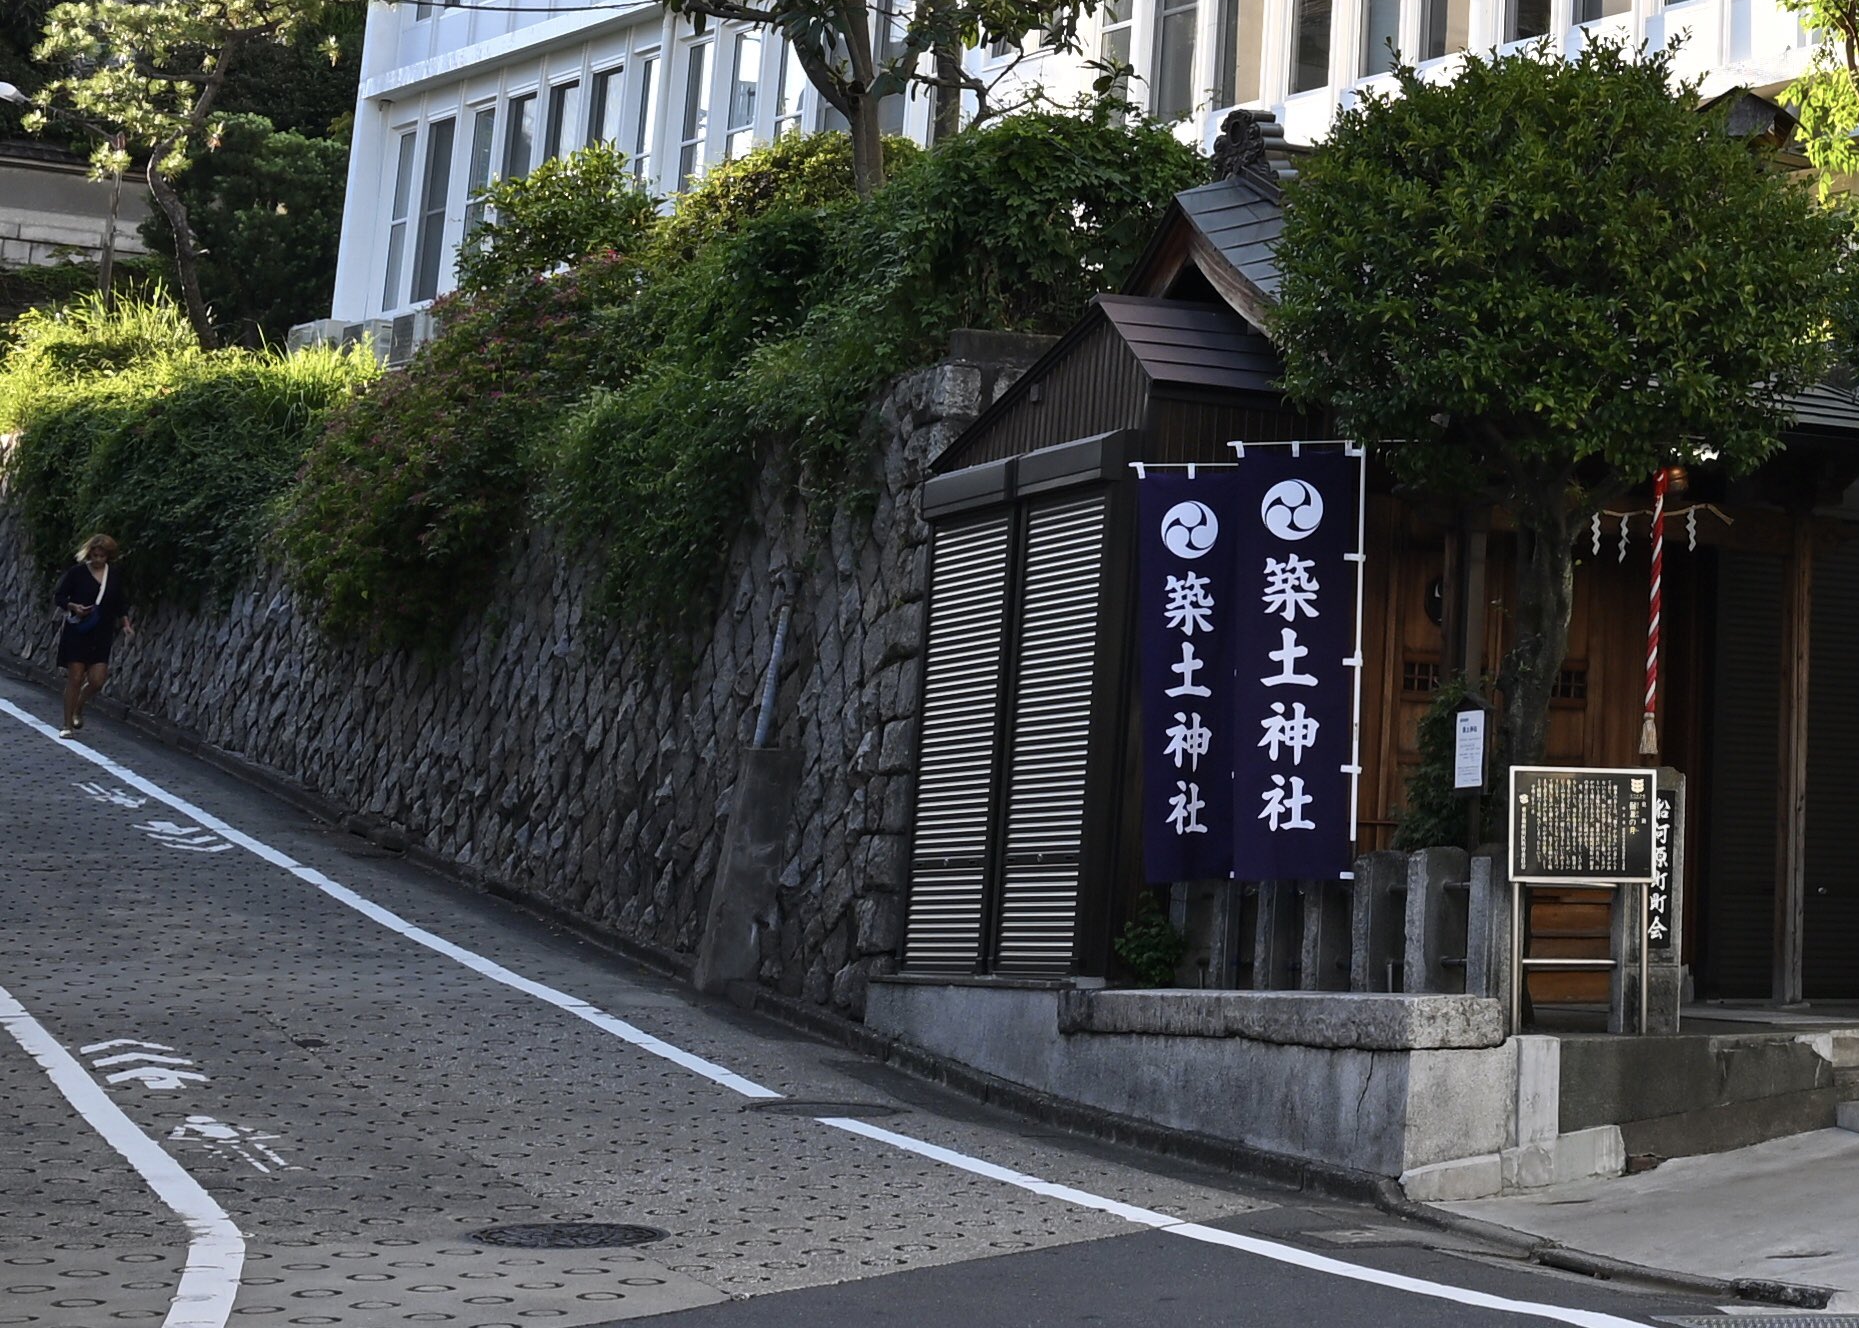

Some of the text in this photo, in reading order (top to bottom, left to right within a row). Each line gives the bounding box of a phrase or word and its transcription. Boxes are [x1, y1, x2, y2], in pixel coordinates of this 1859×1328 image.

[1162, 570, 1216, 836] 築土神社
[1257, 553, 1321, 832] 築土神社
